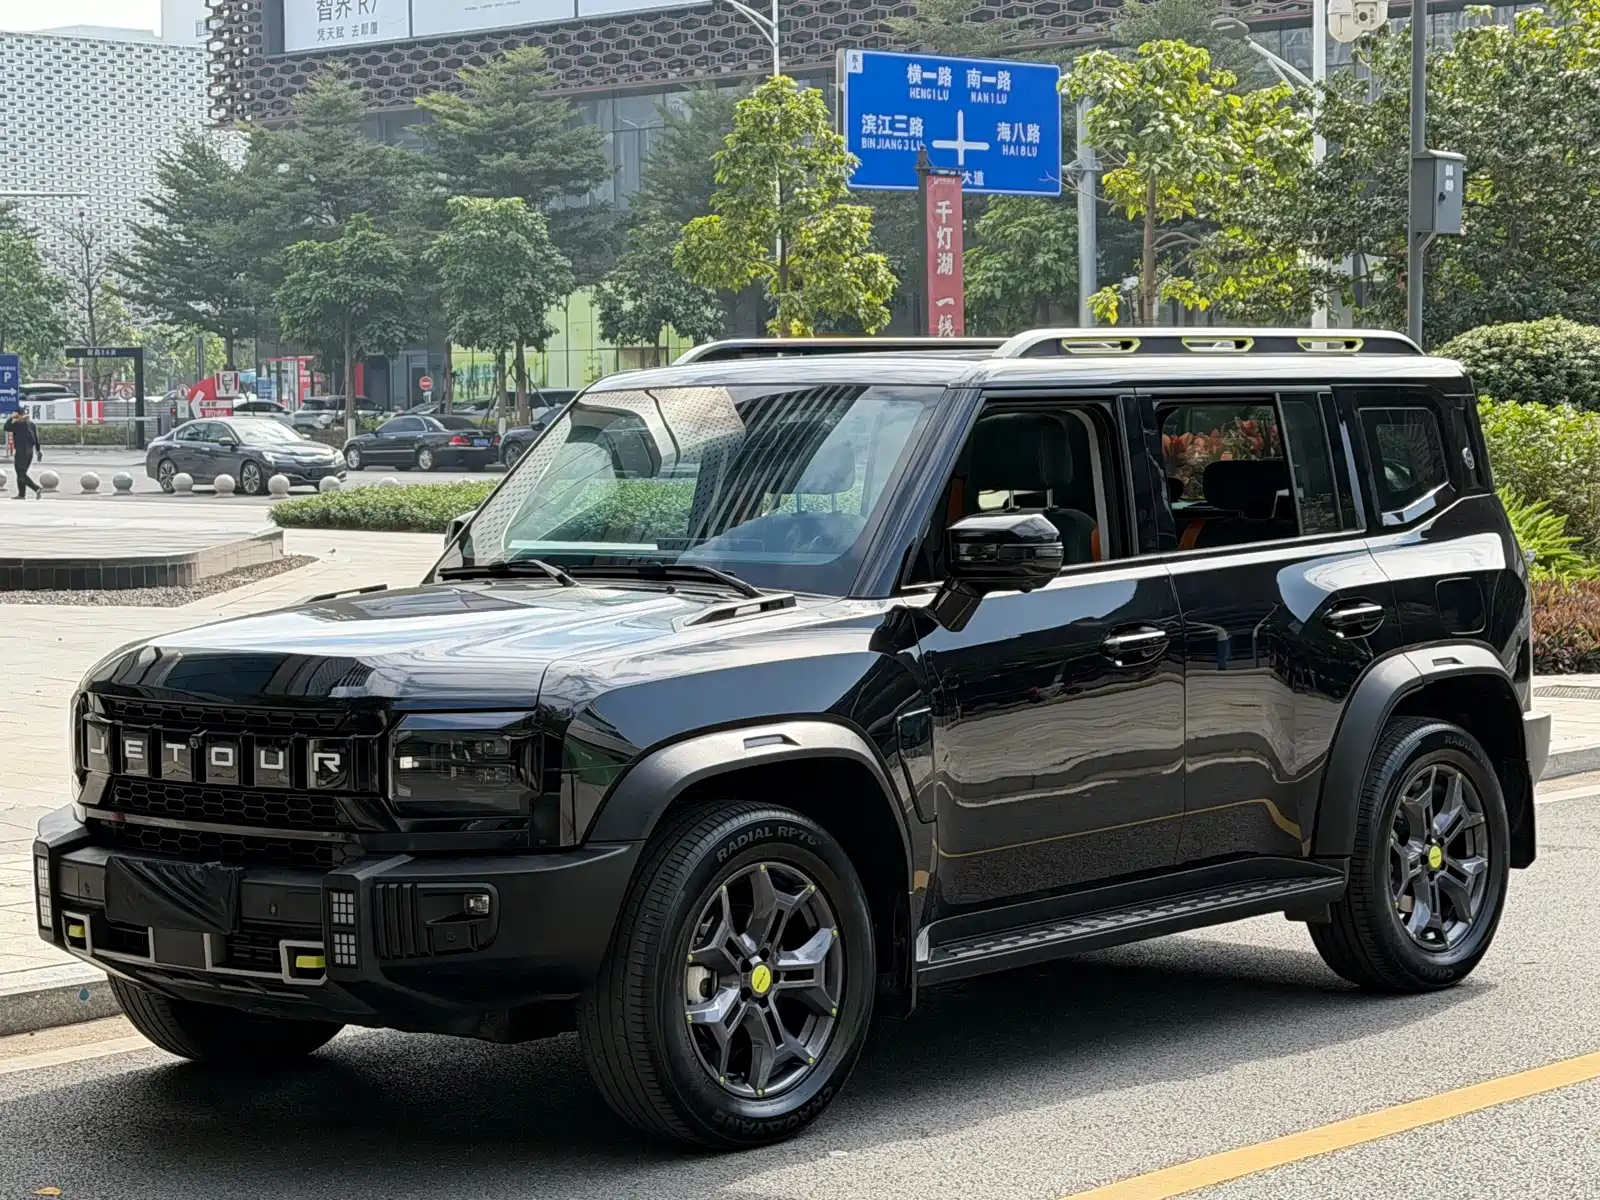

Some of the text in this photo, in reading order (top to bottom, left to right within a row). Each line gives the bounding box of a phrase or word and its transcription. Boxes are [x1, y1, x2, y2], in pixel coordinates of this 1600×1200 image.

[907, 63, 1012, 91] 横一路 南一路
[862, 114, 1040, 143] 滨江三路 海八路
[936, 200, 953, 275] 千灯湖
[90, 736, 341, 773] JETOUR
[716, 826, 774, 862] RADIAL
